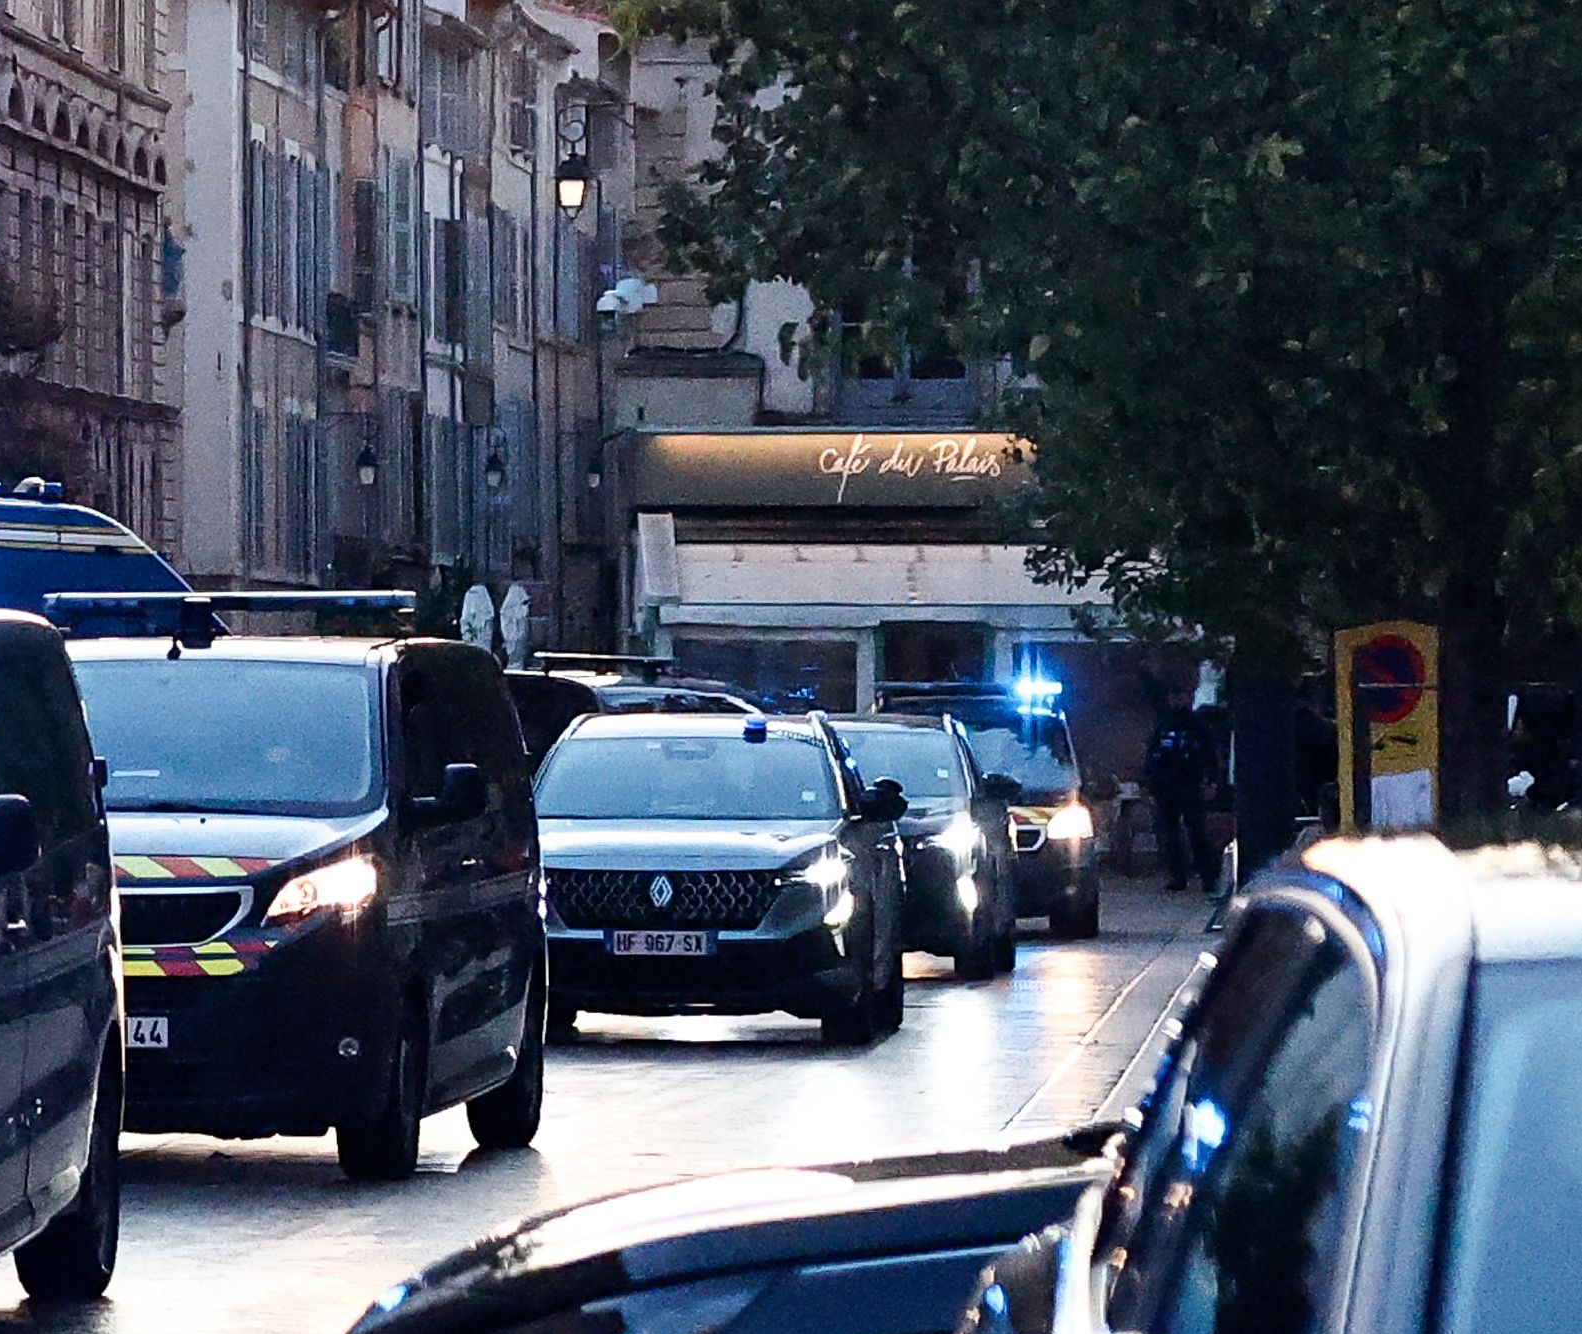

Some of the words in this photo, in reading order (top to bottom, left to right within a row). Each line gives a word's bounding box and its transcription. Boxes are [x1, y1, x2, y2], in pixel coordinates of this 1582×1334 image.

[820, 434, 871, 503] Café
[879, 441, 923, 477] du
[929, 437, 1001, 481] Palais
